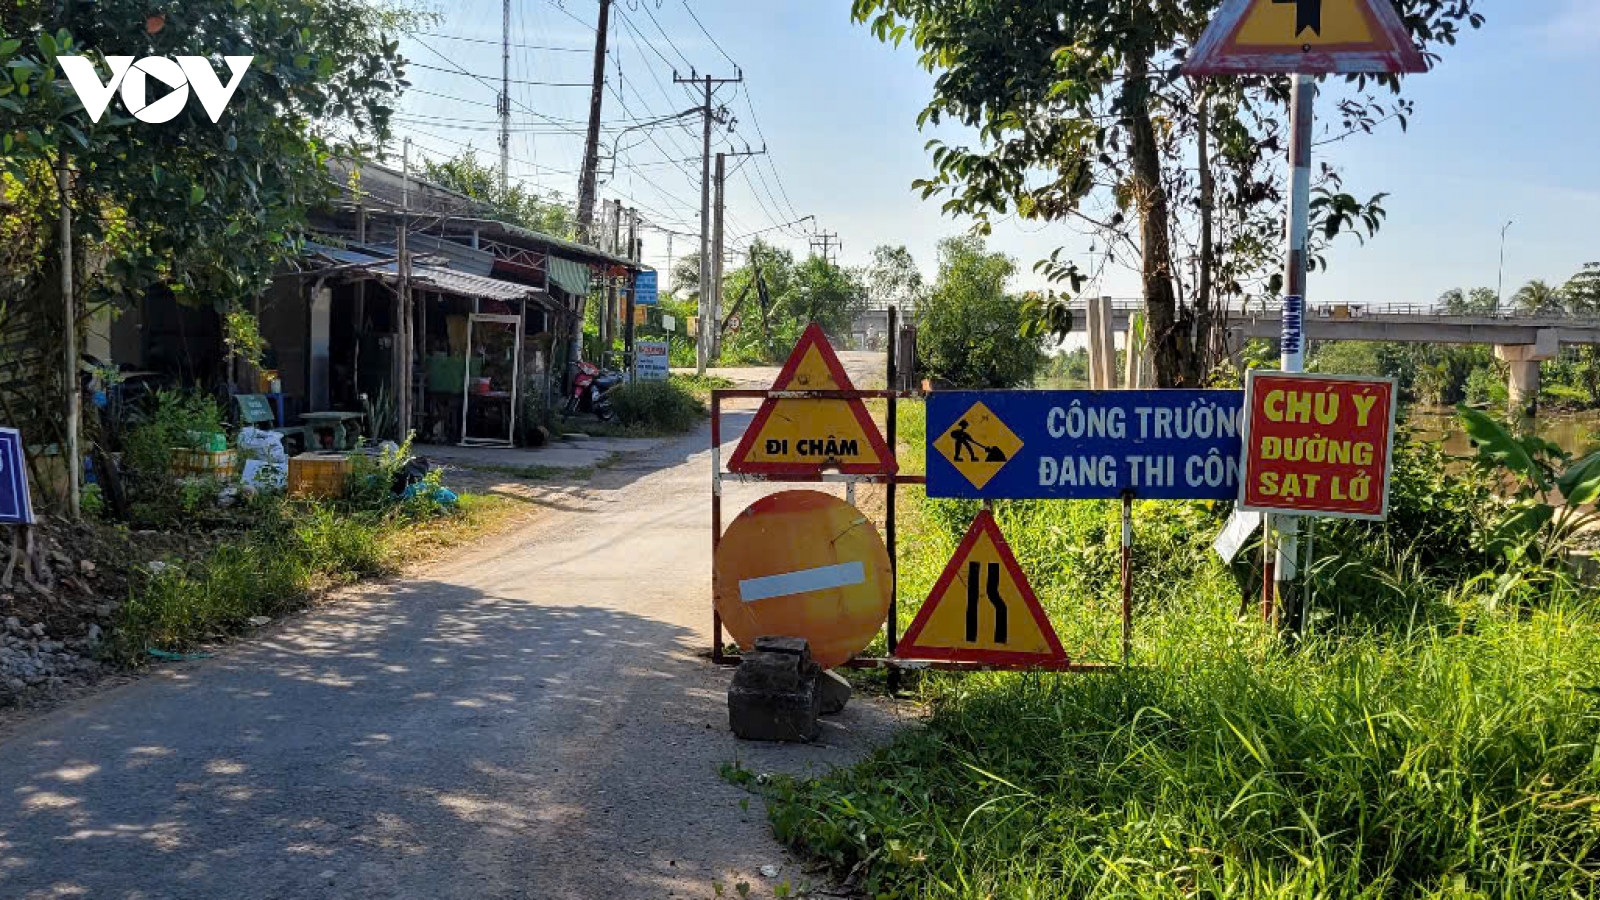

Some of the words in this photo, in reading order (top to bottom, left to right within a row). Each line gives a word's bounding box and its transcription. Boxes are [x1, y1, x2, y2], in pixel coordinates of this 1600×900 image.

[1046, 398, 1127, 438] CÔNG
[1263, 386, 1340, 425] CHÚ
[1352, 387, 1378, 427] Ý
[765, 439, 788, 455] ĐI
[796, 434, 859, 461] CHẬM
[1260, 432, 1374, 466] ĐƯỜNG
[1037, 454, 1118, 487] ĐANG
[1125, 454, 1175, 487] THI
[1184, 447, 1239, 488] CÔN
[1258, 471, 1321, 502] SẠT
[1330, 468, 1371, 502] LỞ
